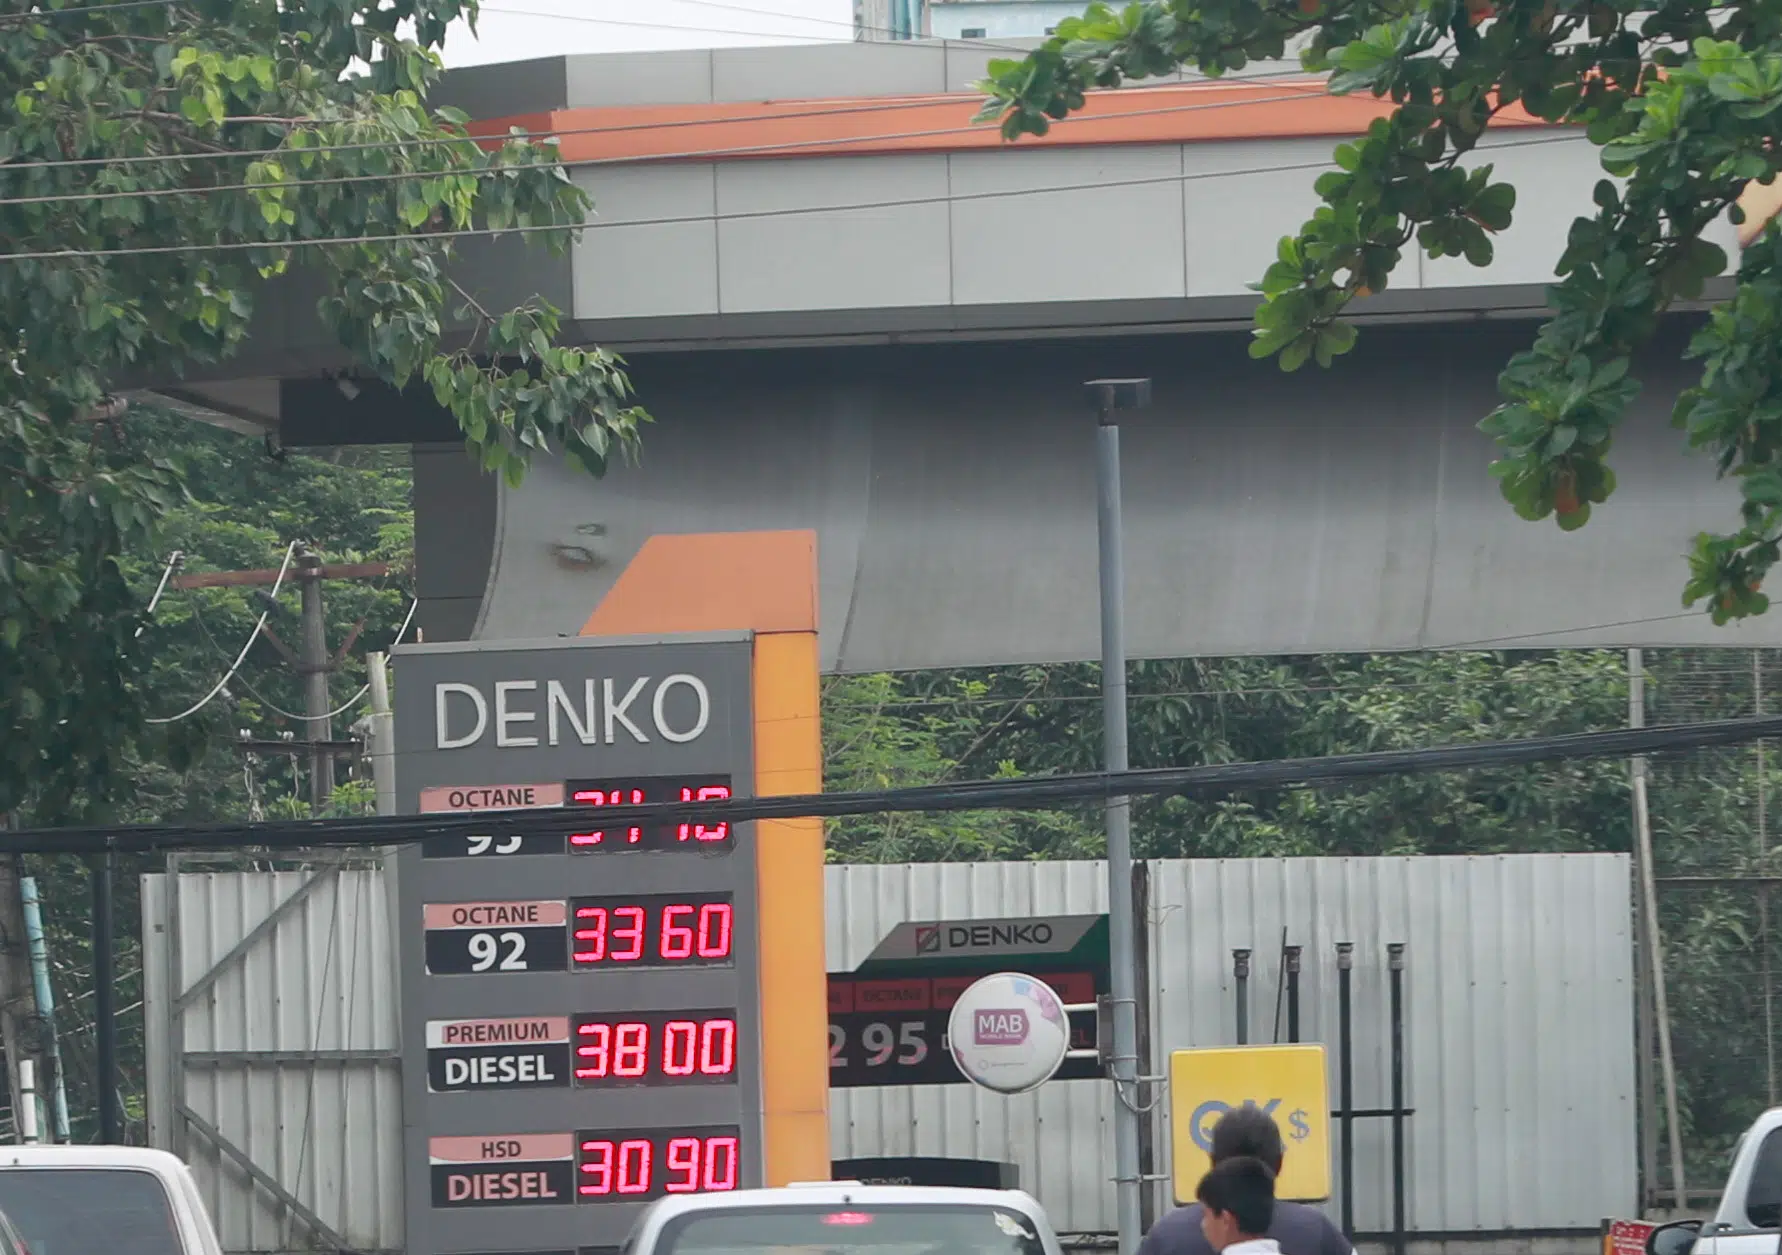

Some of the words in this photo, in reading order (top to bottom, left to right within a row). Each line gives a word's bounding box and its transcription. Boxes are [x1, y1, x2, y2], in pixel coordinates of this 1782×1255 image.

[435, 673, 710, 750] DENKO
[449, 788, 535, 808] OCTANE
[452, 905, 538, 924] OCTANE
[572, 903, 733, 963] 3360
[949, 923, 1053, 948] DENKO
[468, 932, 528, 972] 92
[446, 1022, 549, 1043] PREMIUM
[979, 1014, 1023, 1034] MAB
[575, 1018, 737, 1079] 3800
[862, 1020, 928, 1067] 95
[445, 1055, 555, 1085] DIESEL
[481, 1140, 522, 1159] HSD
[579, 1136, 738, 1196] 3090
[448, 1172, 557, 1201] DIESEL
